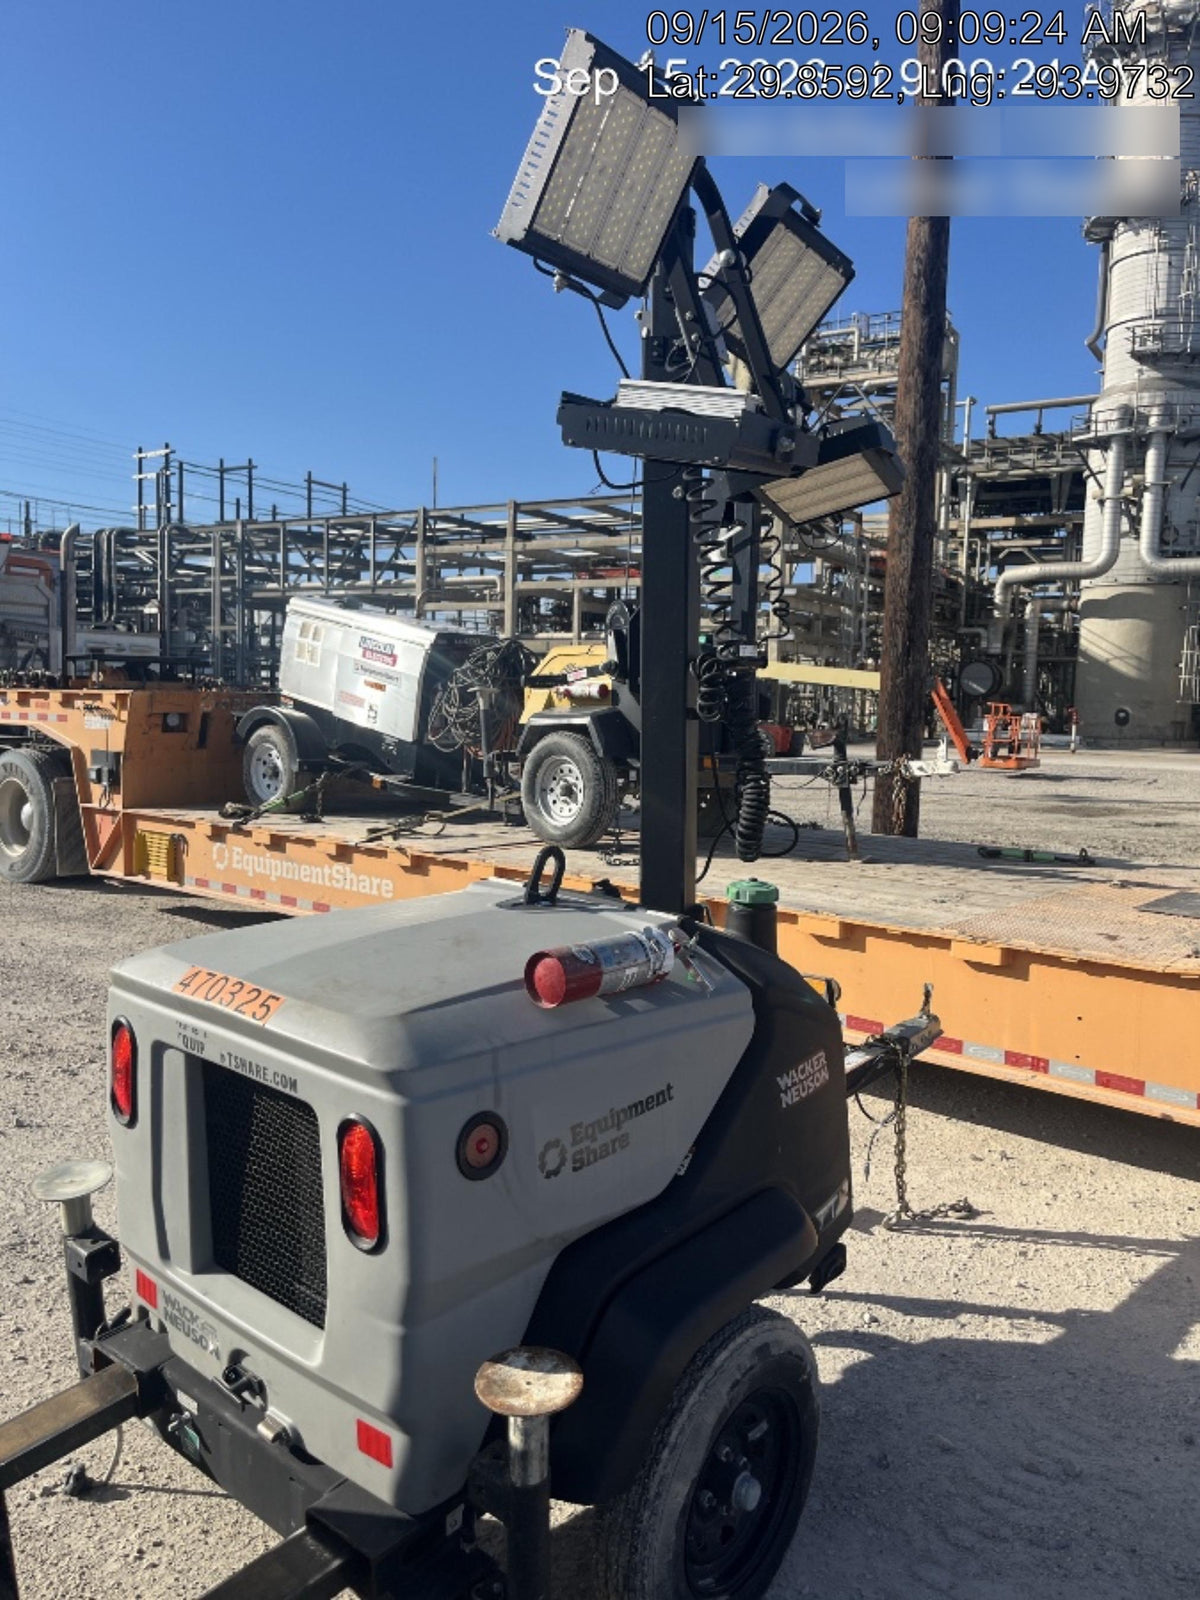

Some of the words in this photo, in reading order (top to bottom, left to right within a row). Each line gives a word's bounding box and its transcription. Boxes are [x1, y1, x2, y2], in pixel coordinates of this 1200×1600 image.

[232, 846, 394, 898] EquipmentShare
[178, 969, 281, 1021] 470325
[776, 1050, 828, 1091] WACKER
[779, 1065, 830, 1109] NEUSON
[569, 1082, 674, 1147] Equipment
[571, 1132, 631, 1172] Share
